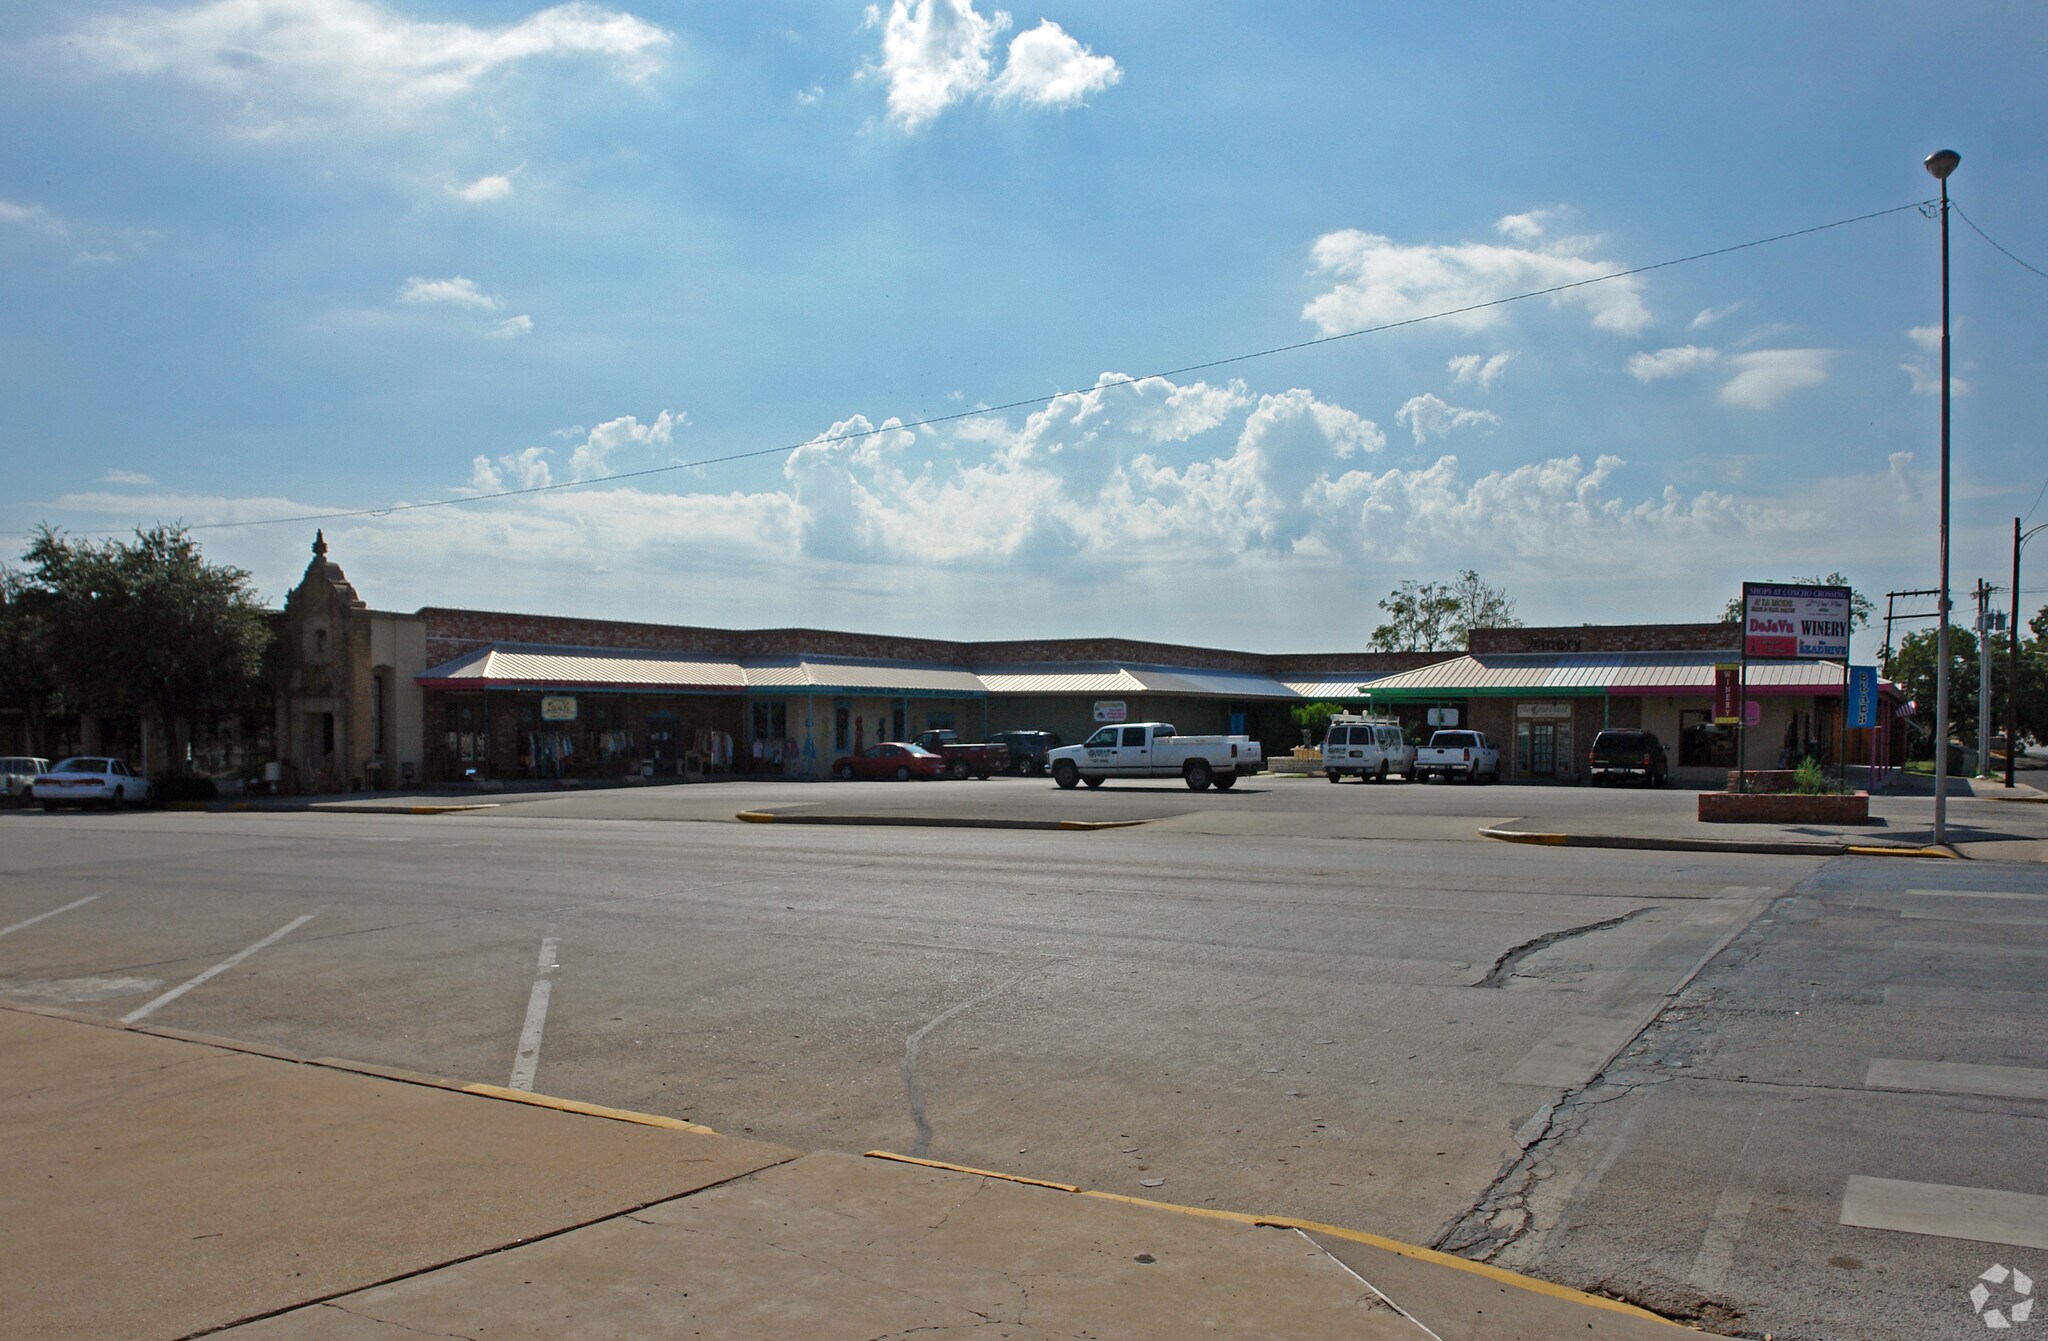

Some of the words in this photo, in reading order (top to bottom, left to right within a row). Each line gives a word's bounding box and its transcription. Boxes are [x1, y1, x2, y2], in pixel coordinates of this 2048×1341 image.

[1782, 589, 1812, 597] CONCHO
[1761, 598, 1770, 607] LA
[1772, 598, 1793, 607] MODE
[1801, 620, 1847, 637] WINERY
[1799, 645, 1823, 654] BEAD
[1824, 646, 1847, 655] HIVE
[1723, 671, 1731, 716] WINERY
[1858, 671, 1869, 724] BEADS
